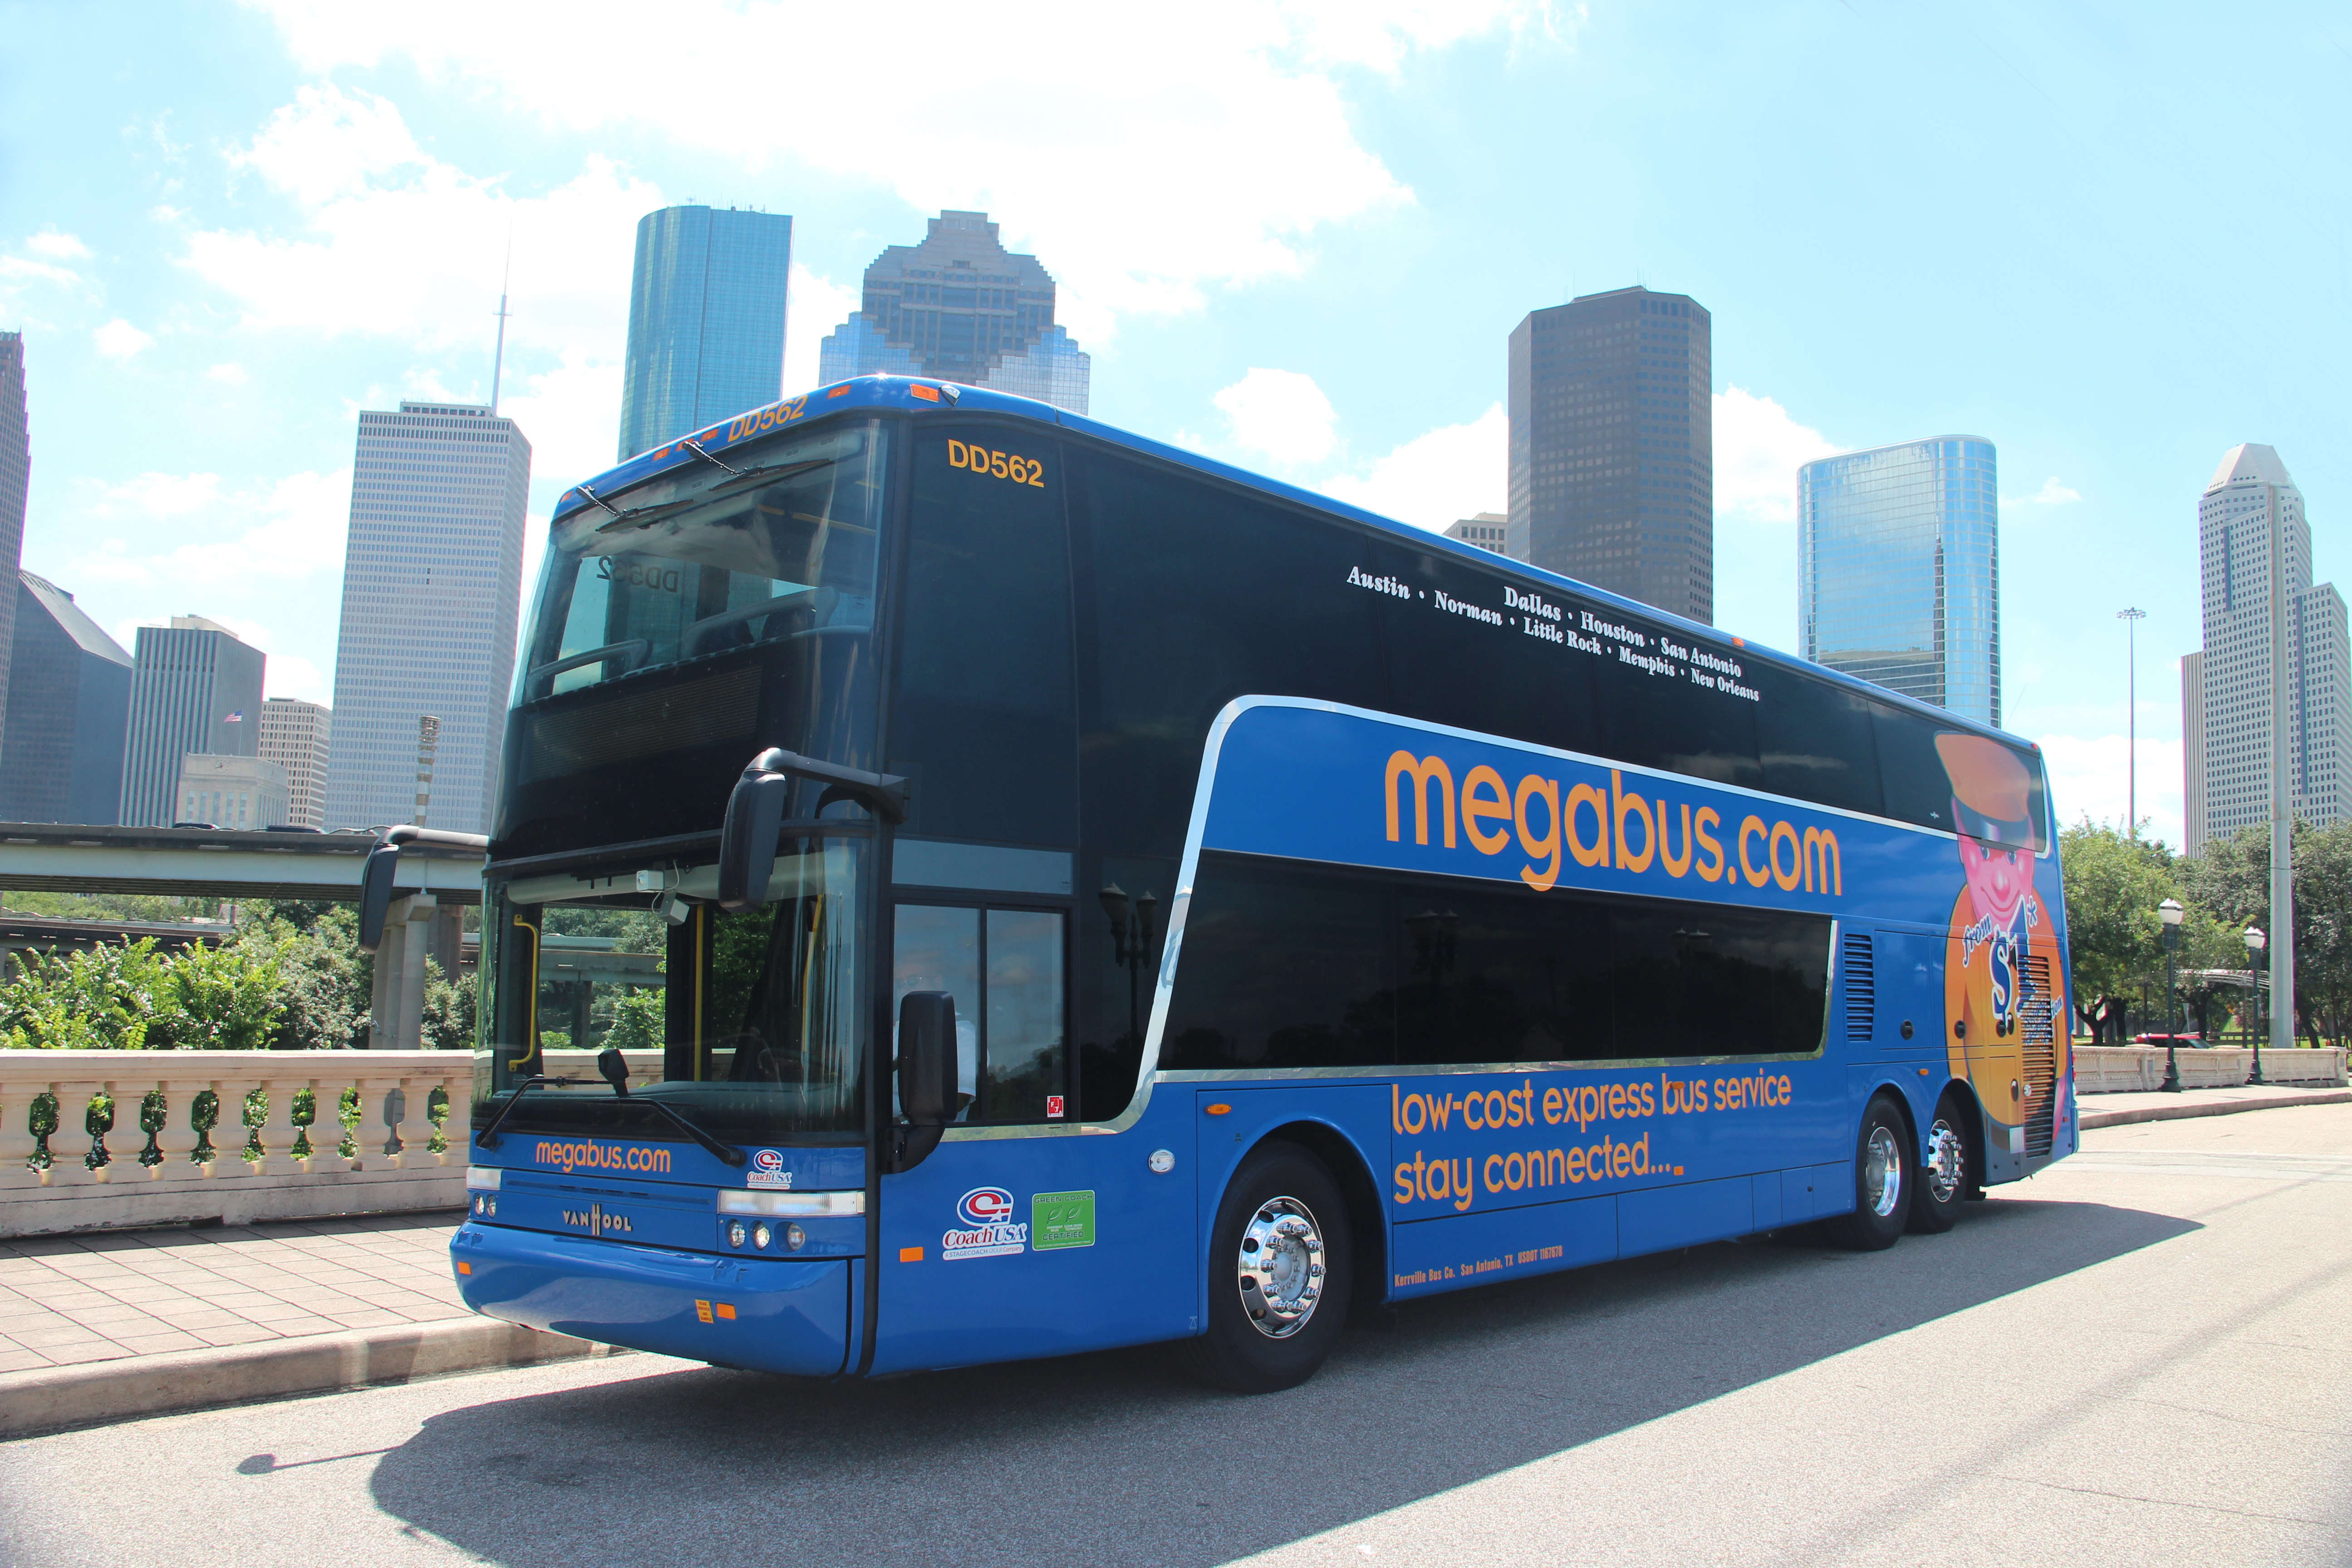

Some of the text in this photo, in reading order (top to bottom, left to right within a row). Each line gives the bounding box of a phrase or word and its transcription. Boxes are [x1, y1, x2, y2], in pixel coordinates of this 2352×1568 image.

[728, 394, 808, 442] DD562
[948, 439, 1044, 488] DD562
[1346, 566, 1759, 702] Austin Norman Little Rock Memphis New Orleans
[1504, 586, 1742, 678] Dallas Houston San Antonio
[1385, 750, 1842, 896] megabus.com
[1962, 913, 1992, 968] from
[1392, 1068, 1791, 1135] low-cost express bus service
[536, 1139, 671, 1173] megabus.com
[1394, 1150, 1473, 1211] stay
[950, 1249, 988, 1257] STAGECOACH
[1043, 1231, 1084, 1240] CERTIFIED
[1395, 1245, 1563, 1287] Kerrville Bus Co. San Antonio, TX USDOT 1167678
